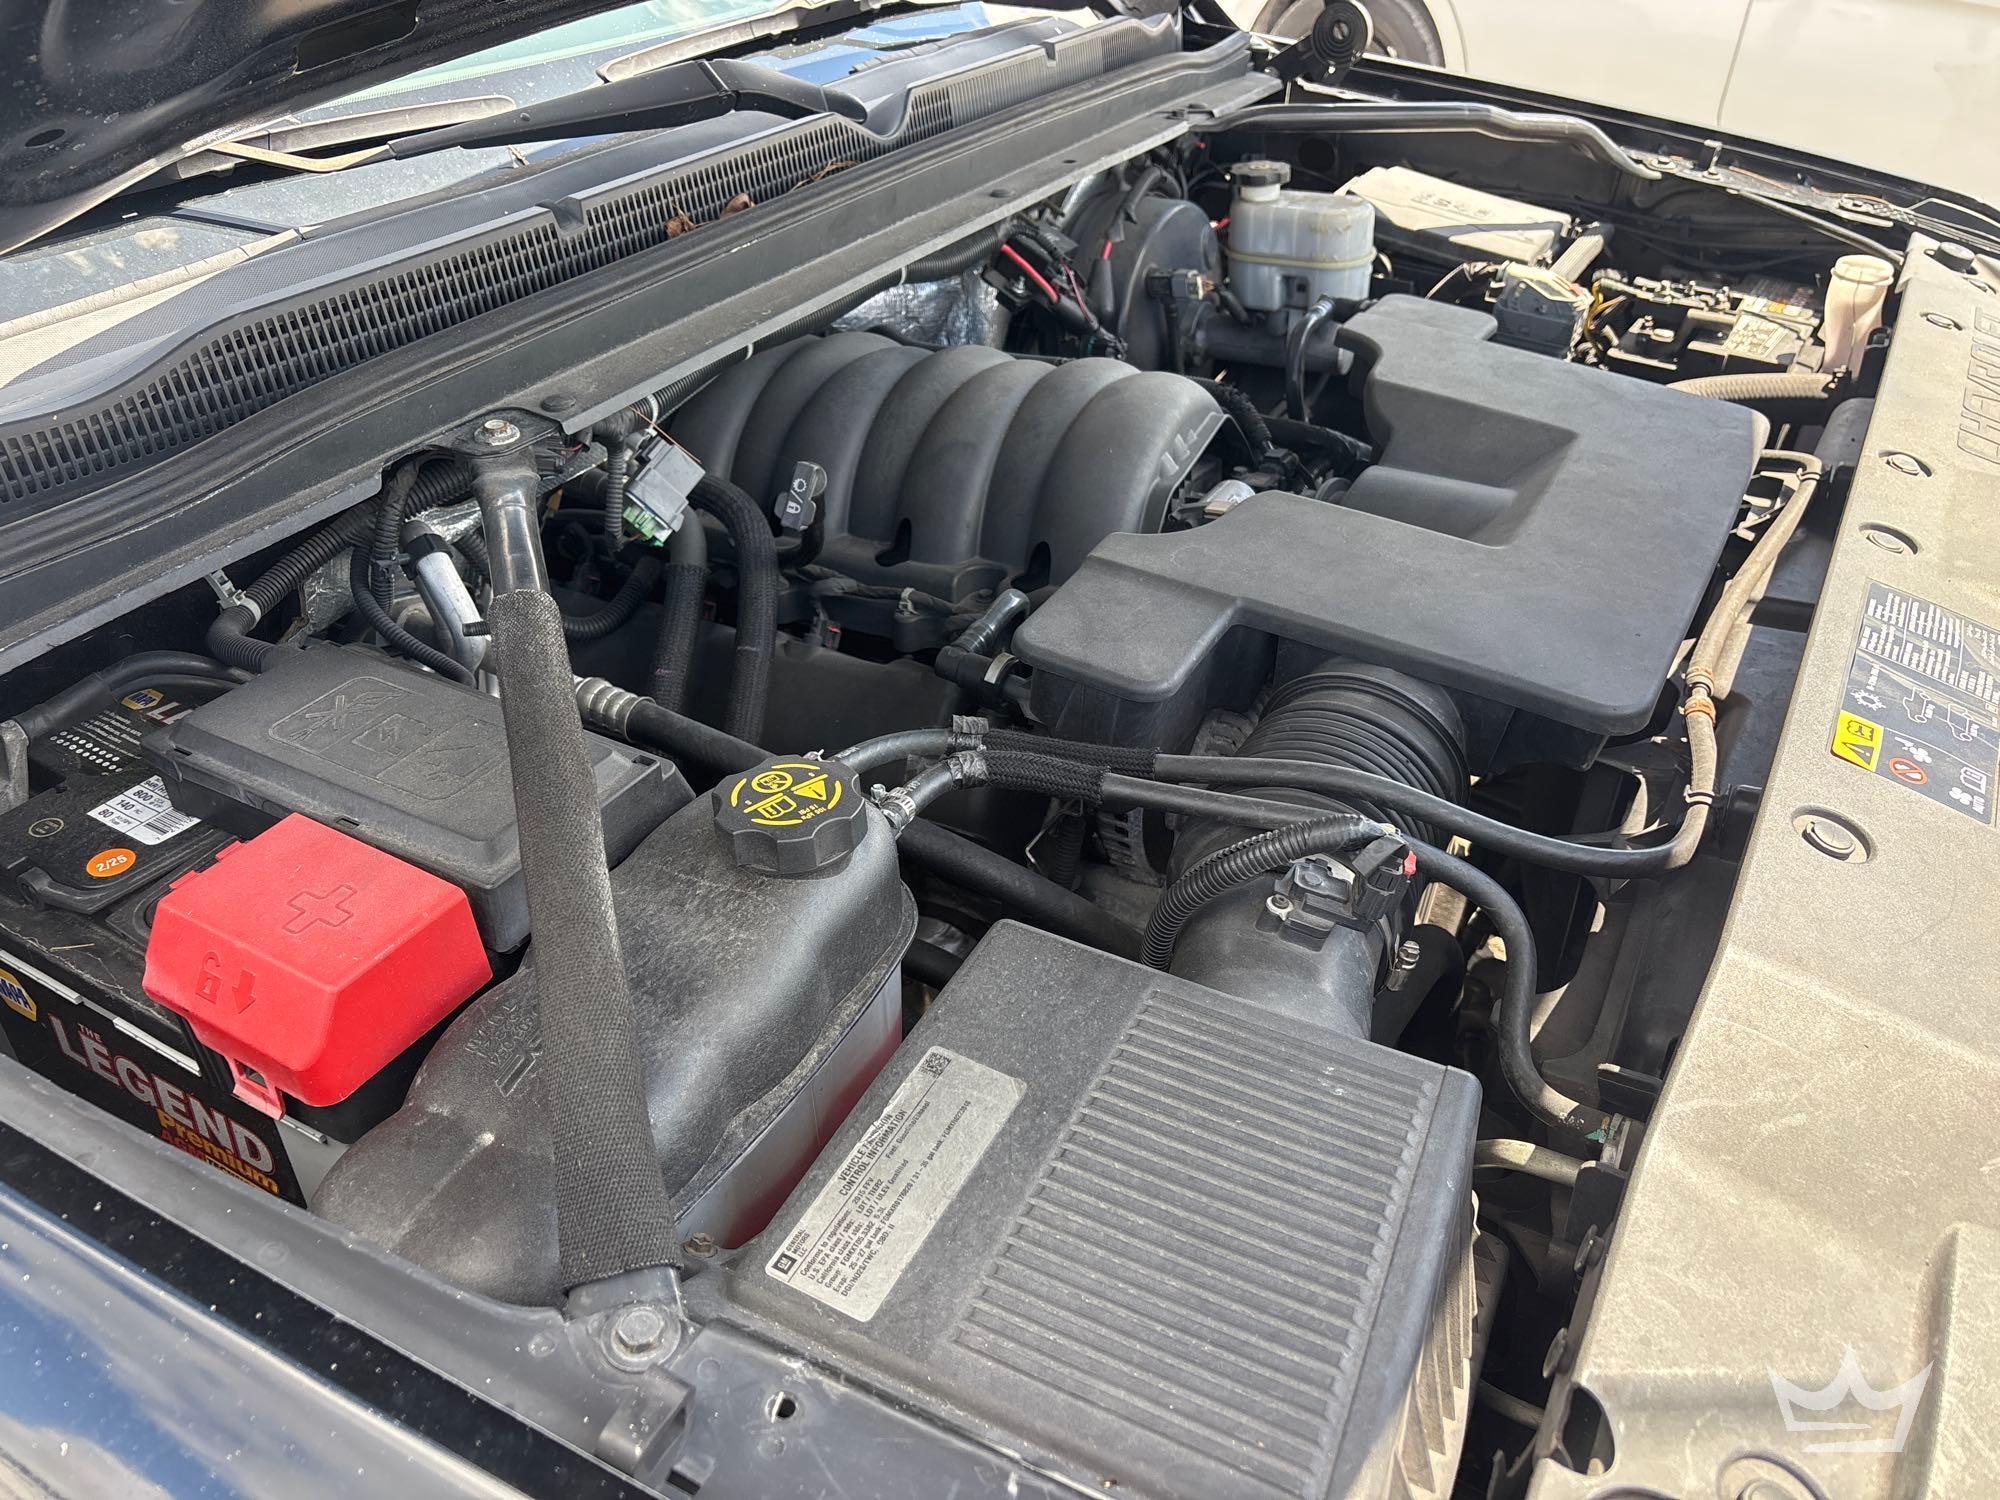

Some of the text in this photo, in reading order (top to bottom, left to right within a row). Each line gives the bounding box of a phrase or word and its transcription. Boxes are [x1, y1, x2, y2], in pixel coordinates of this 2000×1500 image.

[116, 799, 135, 811] 140
[132, 789, 153, 801] 800
[98, 808, 114, 818] 80
[95, 854, 128, 872] 2/25
[77, 1022, 103, 1042] THE
[48, 1012, 275, 1175] LEGEND
[156, 1107, 280, 1195] Premium
[837, 1148, 867, 1182] VEHICLE
[838, 1108, 908, 1197] CONTROL INFORMATION
[791, 1232, 811, 1255] MOTORS
[816, 1255, 841, 1285] California
[836, 1240, 851, 1256] class
[863, 1203, 878, 1218] LDT
[818, 1253, 831, 1266] EPA
[827, 1237, 843, 1253] class
[855, 1199, 870, 1214] LDT
[797, 1247, 809, 1258] LLC
[799, 1248, 824, 1277] Conforms
[819, 1240, 829, 1248] to
